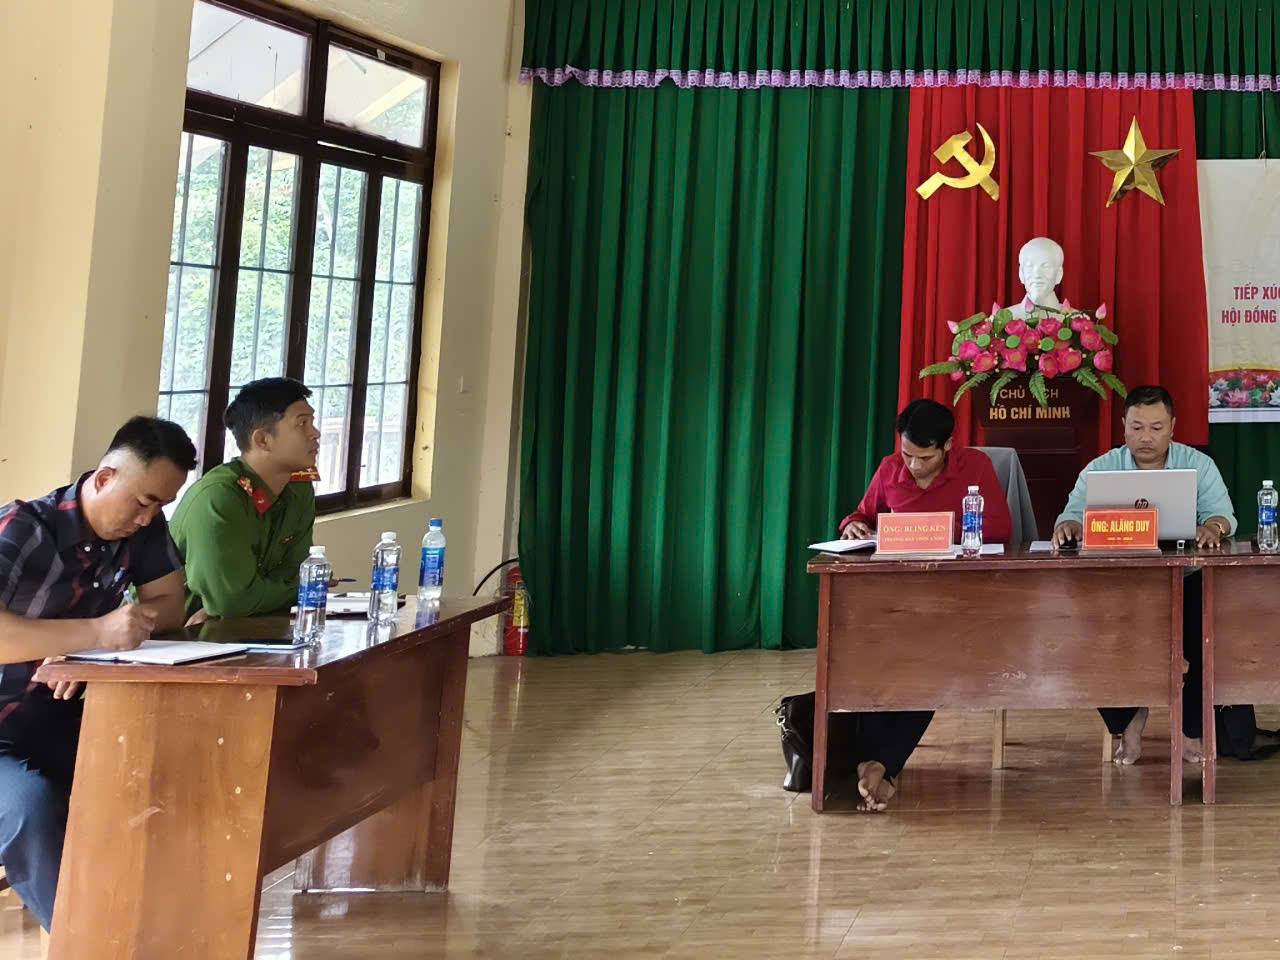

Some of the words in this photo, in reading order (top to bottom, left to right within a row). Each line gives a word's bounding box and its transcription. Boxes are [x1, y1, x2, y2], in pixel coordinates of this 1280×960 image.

[1233, 282, 1259, 300] TIẾP
[1221, 307, 1241, 327] HỘI
[1000, 385, 1026, 399] CHỦ
[989, 402, 1007, 420] HỒ
[1010, 404, 1032, 420] CHÍ
[1035, 406, 1071, 420] MINH
[1135, 520, 1150, 532] DUY
